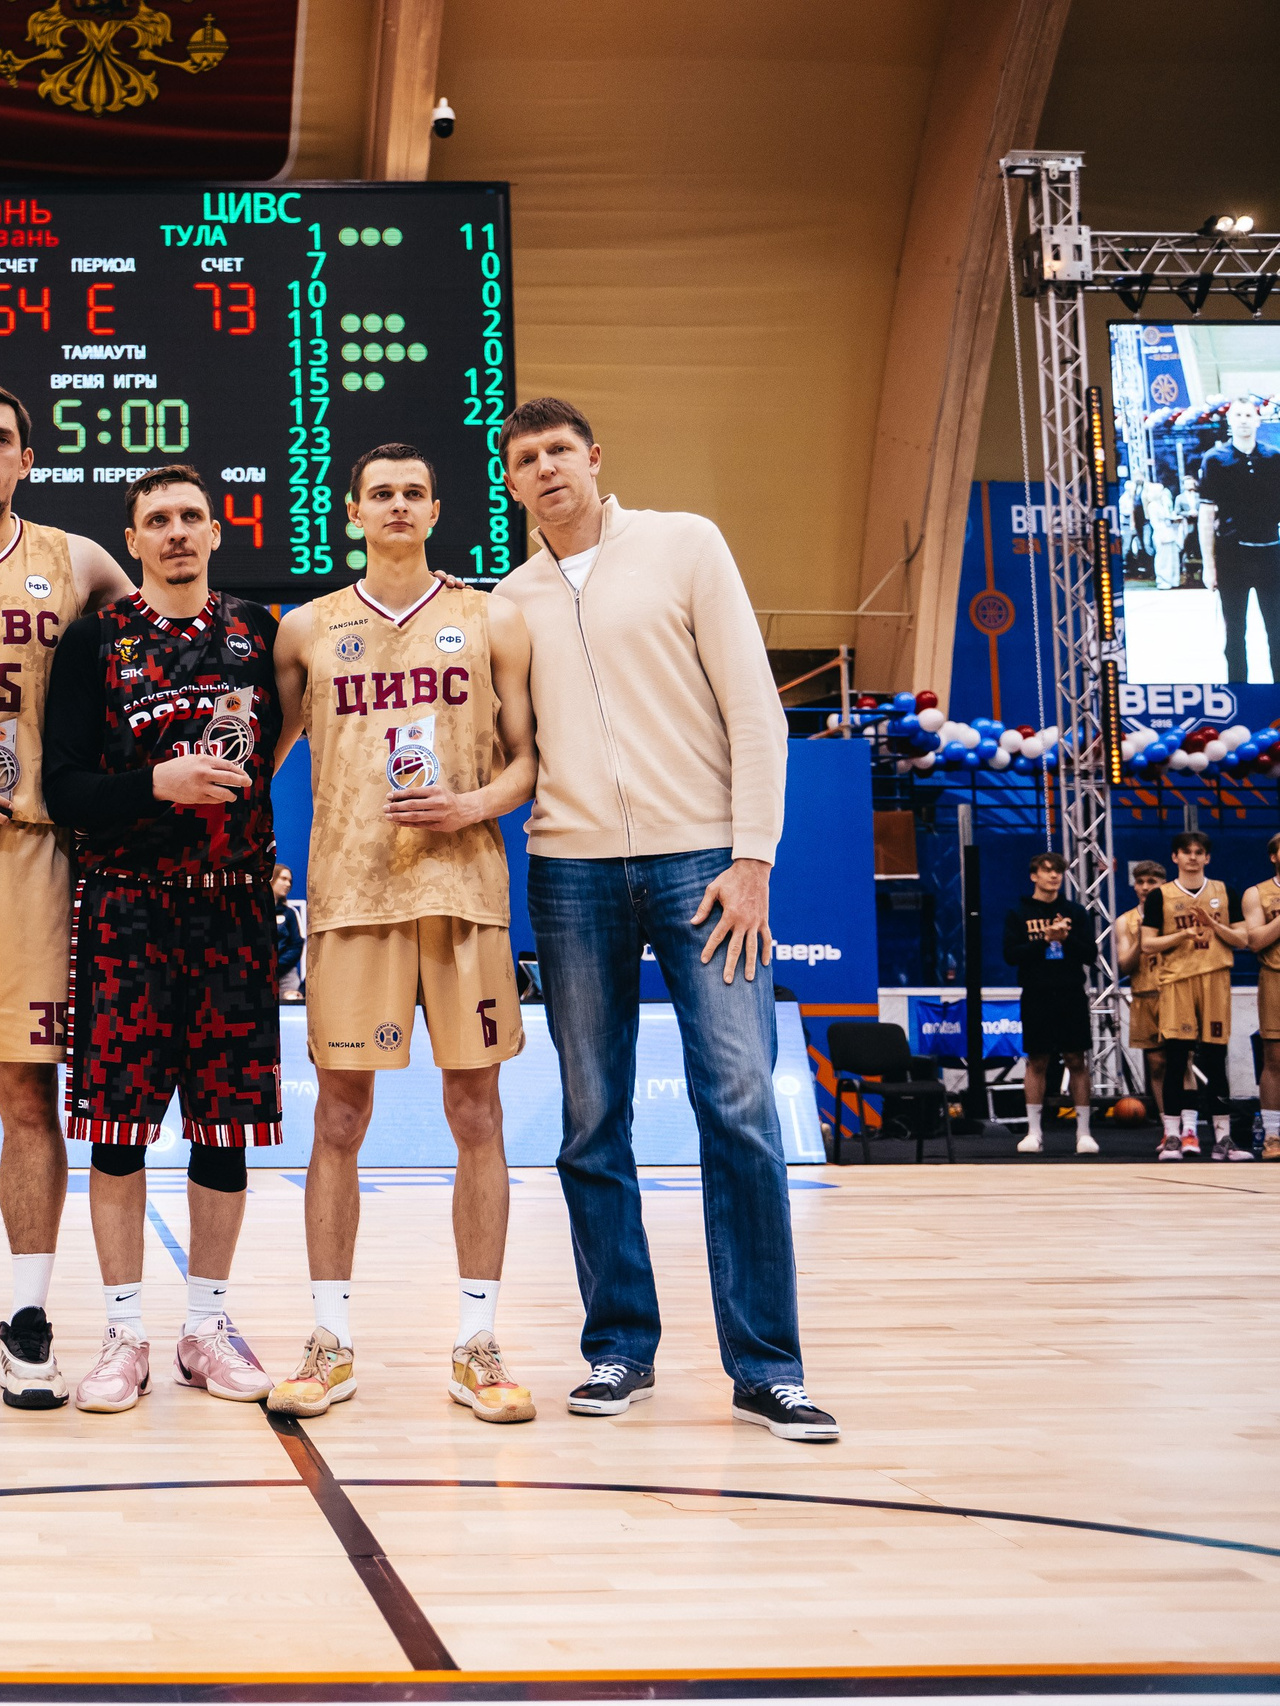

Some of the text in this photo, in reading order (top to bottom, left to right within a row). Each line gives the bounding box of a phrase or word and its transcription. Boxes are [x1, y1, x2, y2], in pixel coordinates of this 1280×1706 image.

[203, 192, 302, 224] ЦИВС
[160, 225, 228, 247] ТУЛА
[309, 223, 494, 250] 1 11
[71, 257, 136, 273] ПЕРИОД
[201, 257, 244, 273] СЧЕТ
[307, 252, 500, 279] 7 0
[288, 281, 501, 308] 10 0
[193, 282, 256, 336] 73
[288, 309, 502, 337] 11 2
[61, 344, 146, 360] ТАЙМАУТЫ
[289, 338, 503, 366] 13 0
[50, 373, 157, 389] ВРЕМЯ ИГРЫ
[289, 368, 504, 395] 15 12
[290, 397, 504, 425] 17 22
[53, 399, 190, 454] 5:00
[289, 426, 502, 454] 23 0
[30, 467, 165, 484] ВРЕМЯ ПЕРЕР
[220, 467, 266, 483] ФОЛЫ
[289, 456, 505, 484] 27 0
[290, 486, 508, 514] 28 5
[224, 493, 263, 549] 4
[290, 515, 509, 543] 31 8
[291, 545, 510, 574] 35 13
[229, 640, 249, 651] РФБ
[439, 634, 462, 644] РФБ
[120, 667, 144, 680] STK
[333, 666, 470, 716] ЦИВС
[1118, 683, 1233, 718] ВЕРЬ
[128, 697, 259, 738] РЯЗА
